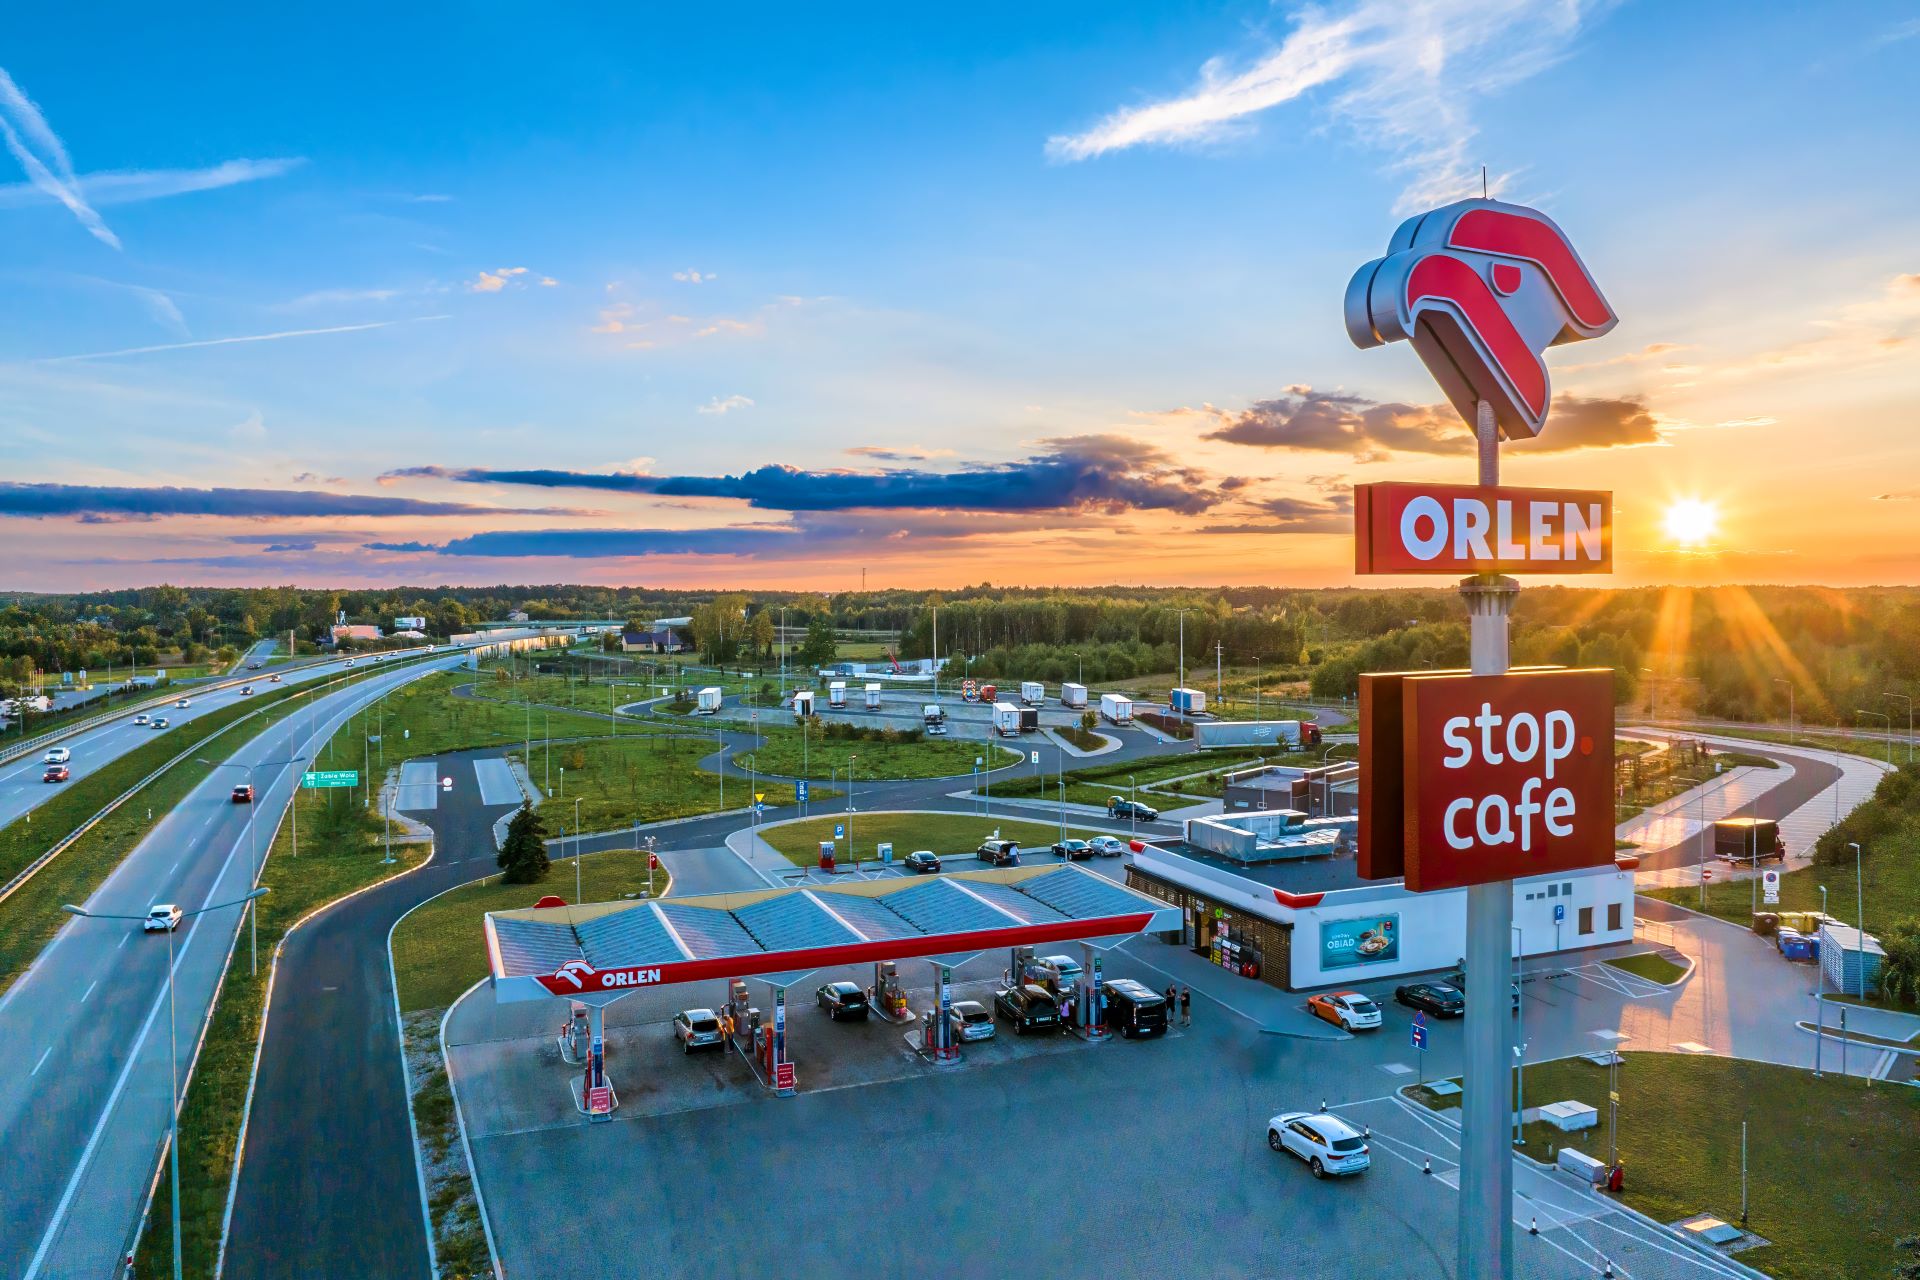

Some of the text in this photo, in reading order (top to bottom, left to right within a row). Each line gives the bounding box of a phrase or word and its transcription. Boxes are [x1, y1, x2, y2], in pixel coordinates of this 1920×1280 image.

[1400, 495, 1602, 561] ORLEN
[1443, 777, 1576, 852] cafe
[1327, 938, 1355, 949] OBIAD
[602, 969, 660, 987] ORLEN
